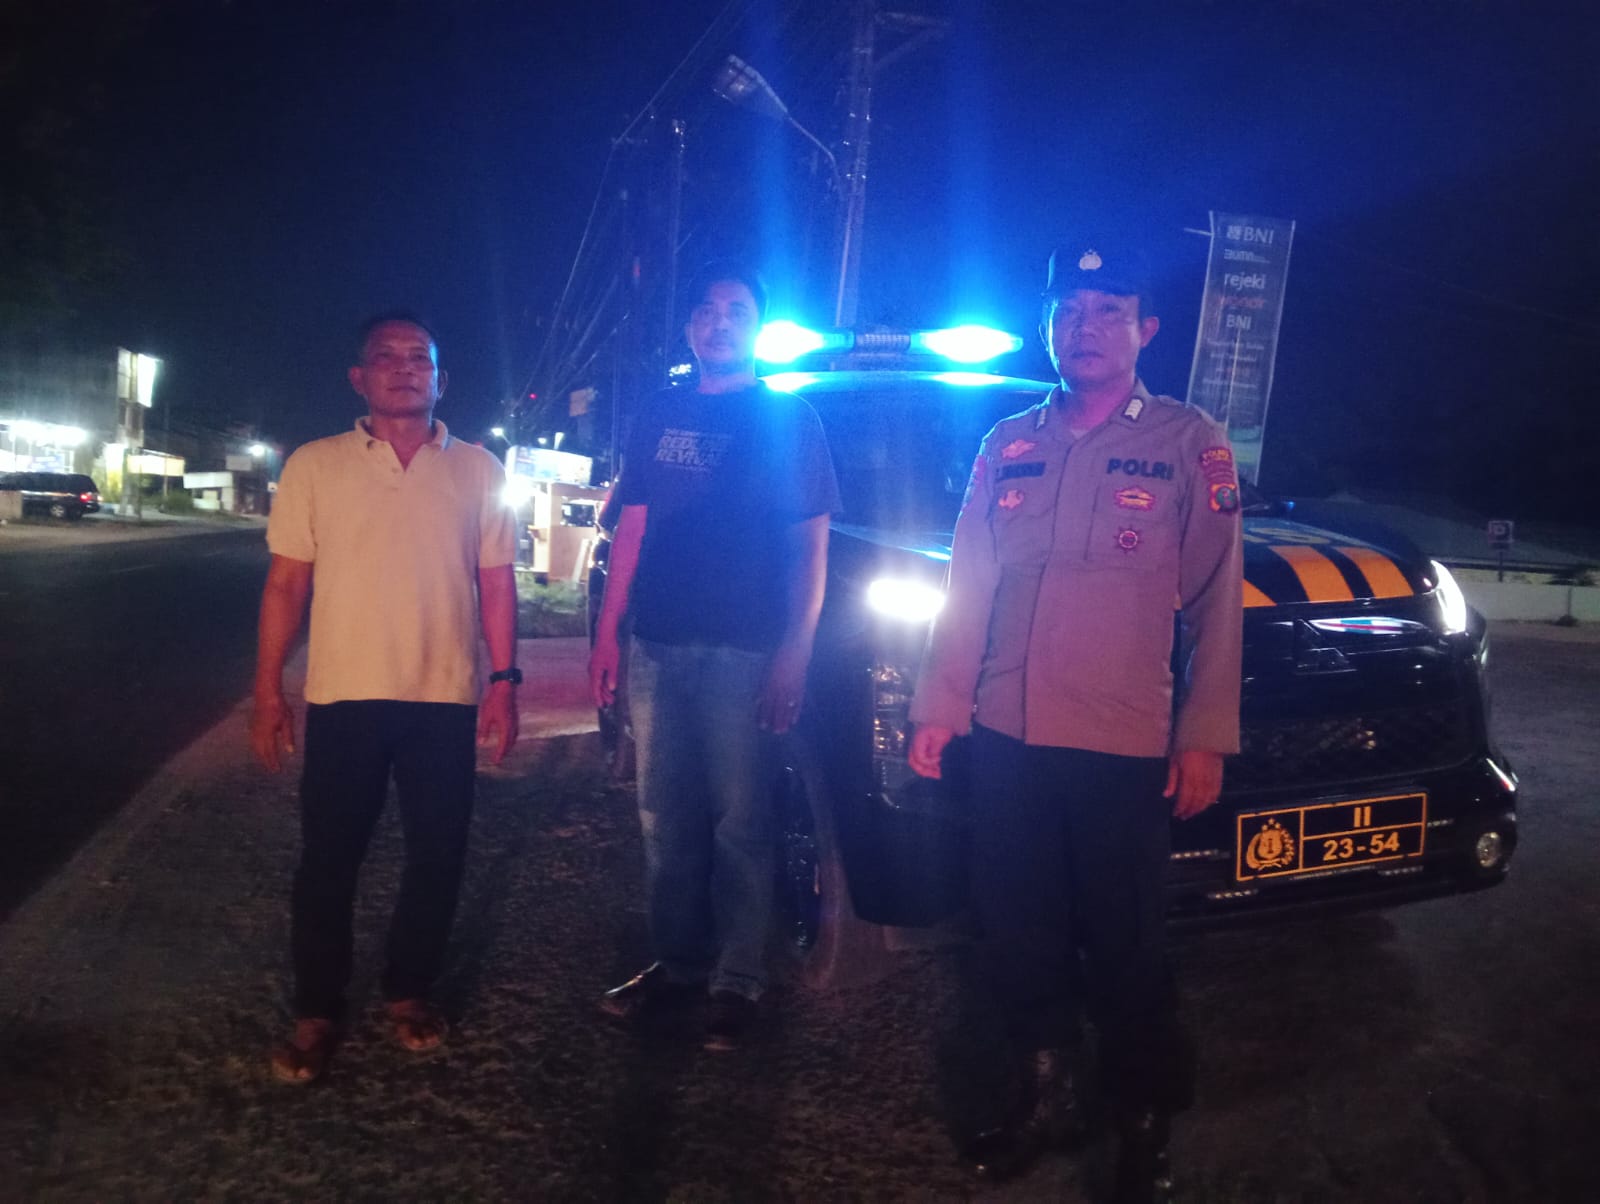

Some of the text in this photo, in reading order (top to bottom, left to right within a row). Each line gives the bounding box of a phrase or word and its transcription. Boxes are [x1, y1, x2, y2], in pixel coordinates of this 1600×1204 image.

[1243, 225, 1275, 244] BNI
[1224, 272, 1266, 291] rejeki
[1226, 314, 1252, 330] BNI
[1106, 458, 1174, 481] POLRI
[1323, 832, 1399, 861] 23-54
